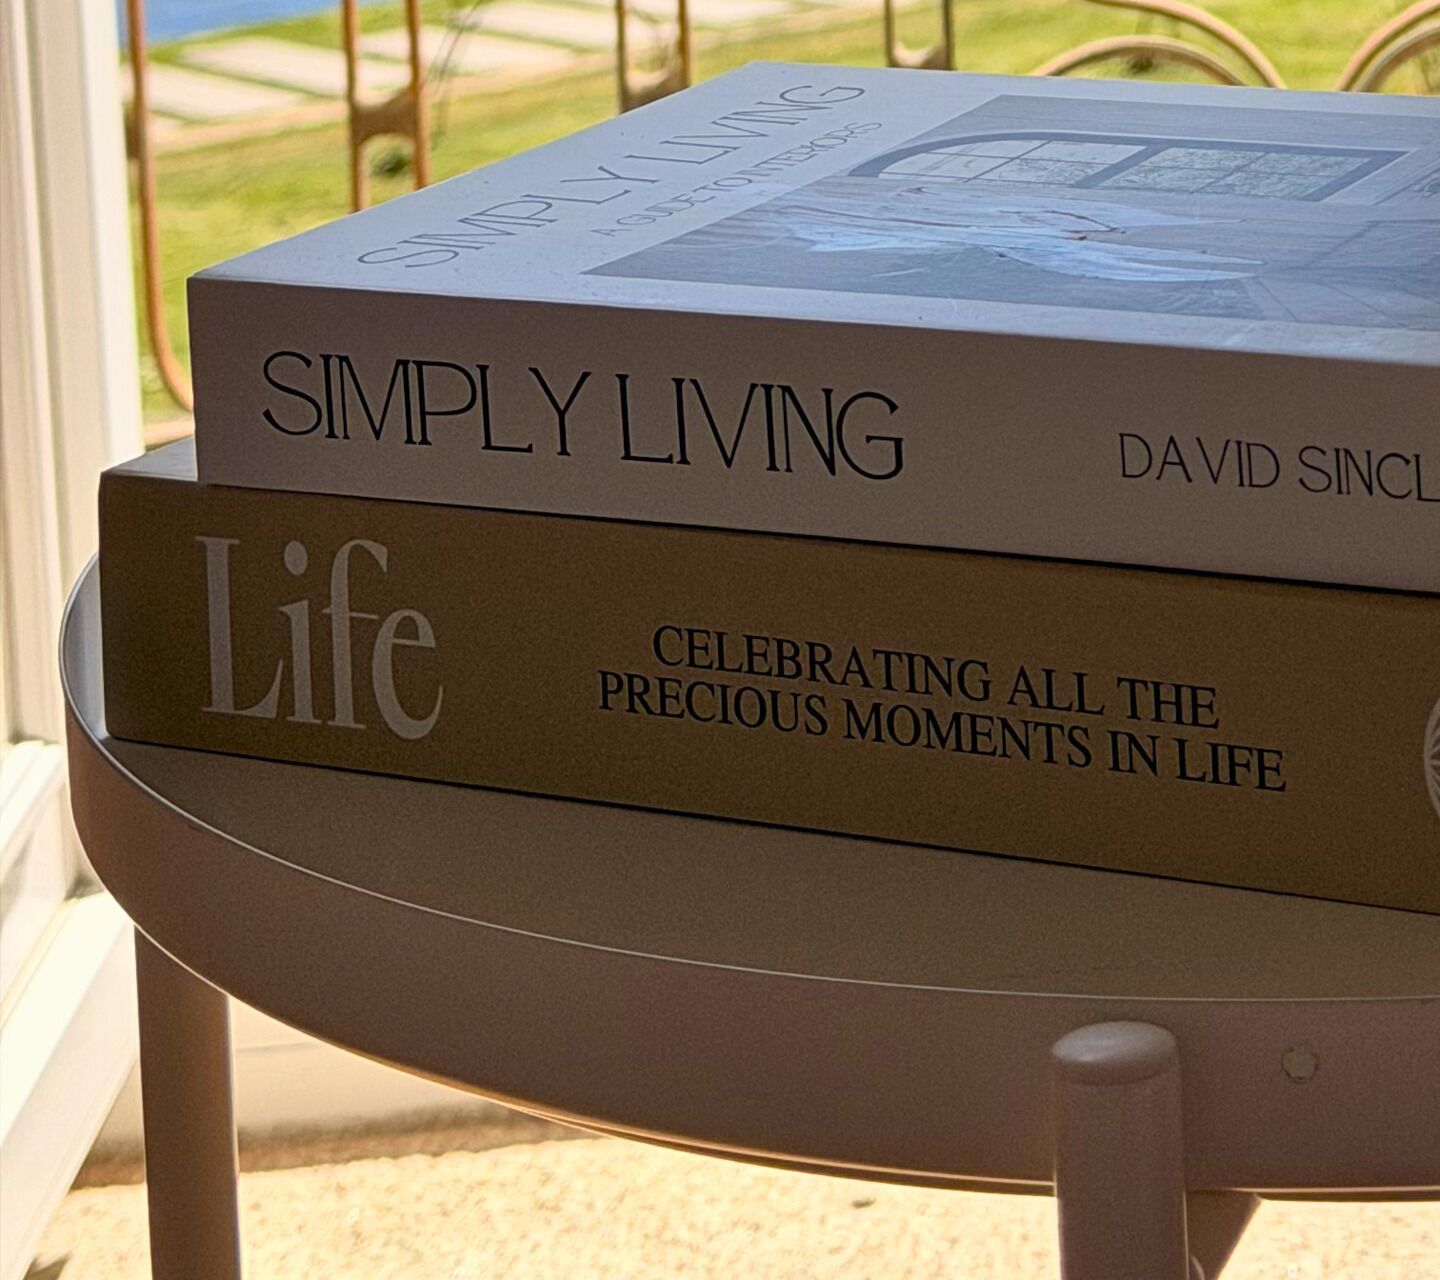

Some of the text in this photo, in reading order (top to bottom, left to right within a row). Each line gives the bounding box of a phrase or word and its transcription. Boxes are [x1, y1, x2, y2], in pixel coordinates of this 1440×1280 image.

[357, 84, 866, 269] SIMPLY LIVING
[589, 121, 883, 238] A GUIDE TO INTERIORS
[261, 350, 905, 481] SIMPLY LIVING
[1118, 433, 1281, 489] DAVID
[195, 535, 444, 741] Life
[652, 624, 1221, 730] CELEBRATING ALL THE
[597, 669, 1287, 792] PRECIOUS MOMENTS IN LIFE
